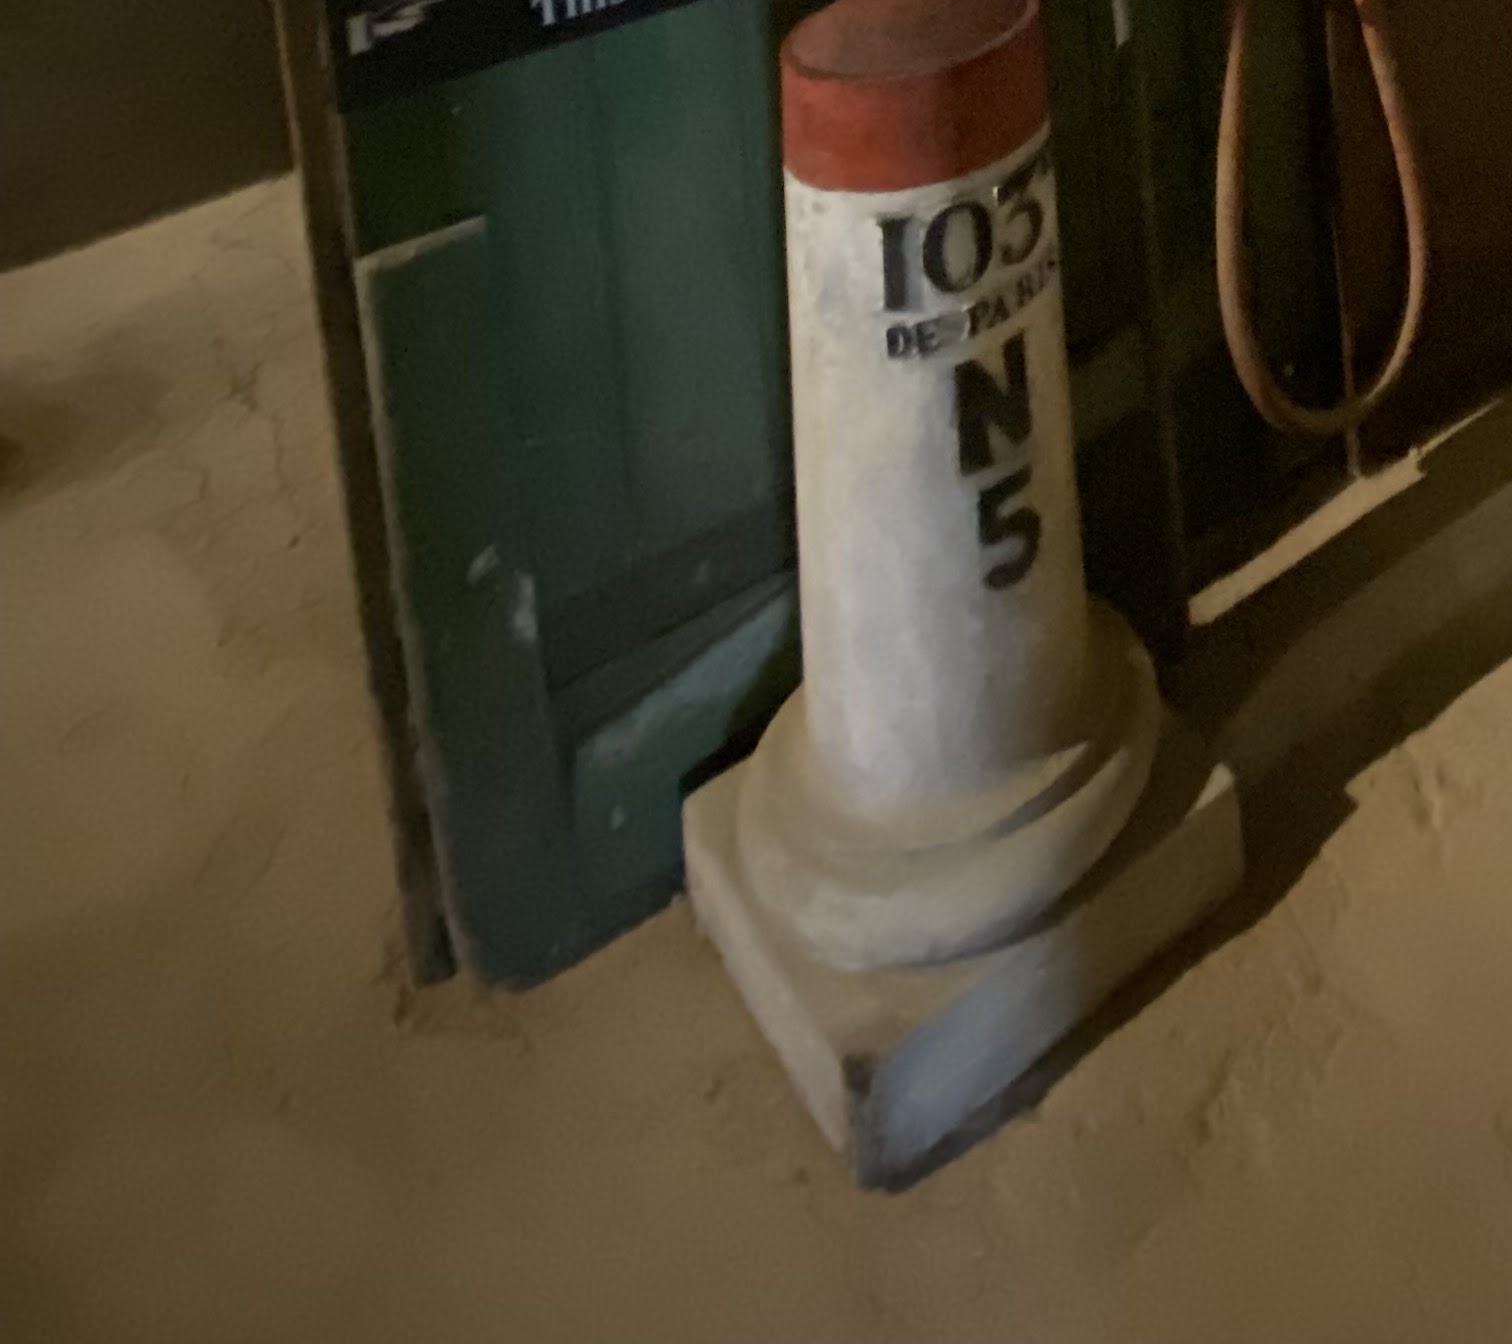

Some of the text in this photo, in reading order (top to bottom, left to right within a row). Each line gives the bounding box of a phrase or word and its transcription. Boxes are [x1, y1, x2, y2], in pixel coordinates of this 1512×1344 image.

[886, 318, 944, 358] DE
[954, 332, 1032, 477] N
[978, 468, 1042, 592] 5
